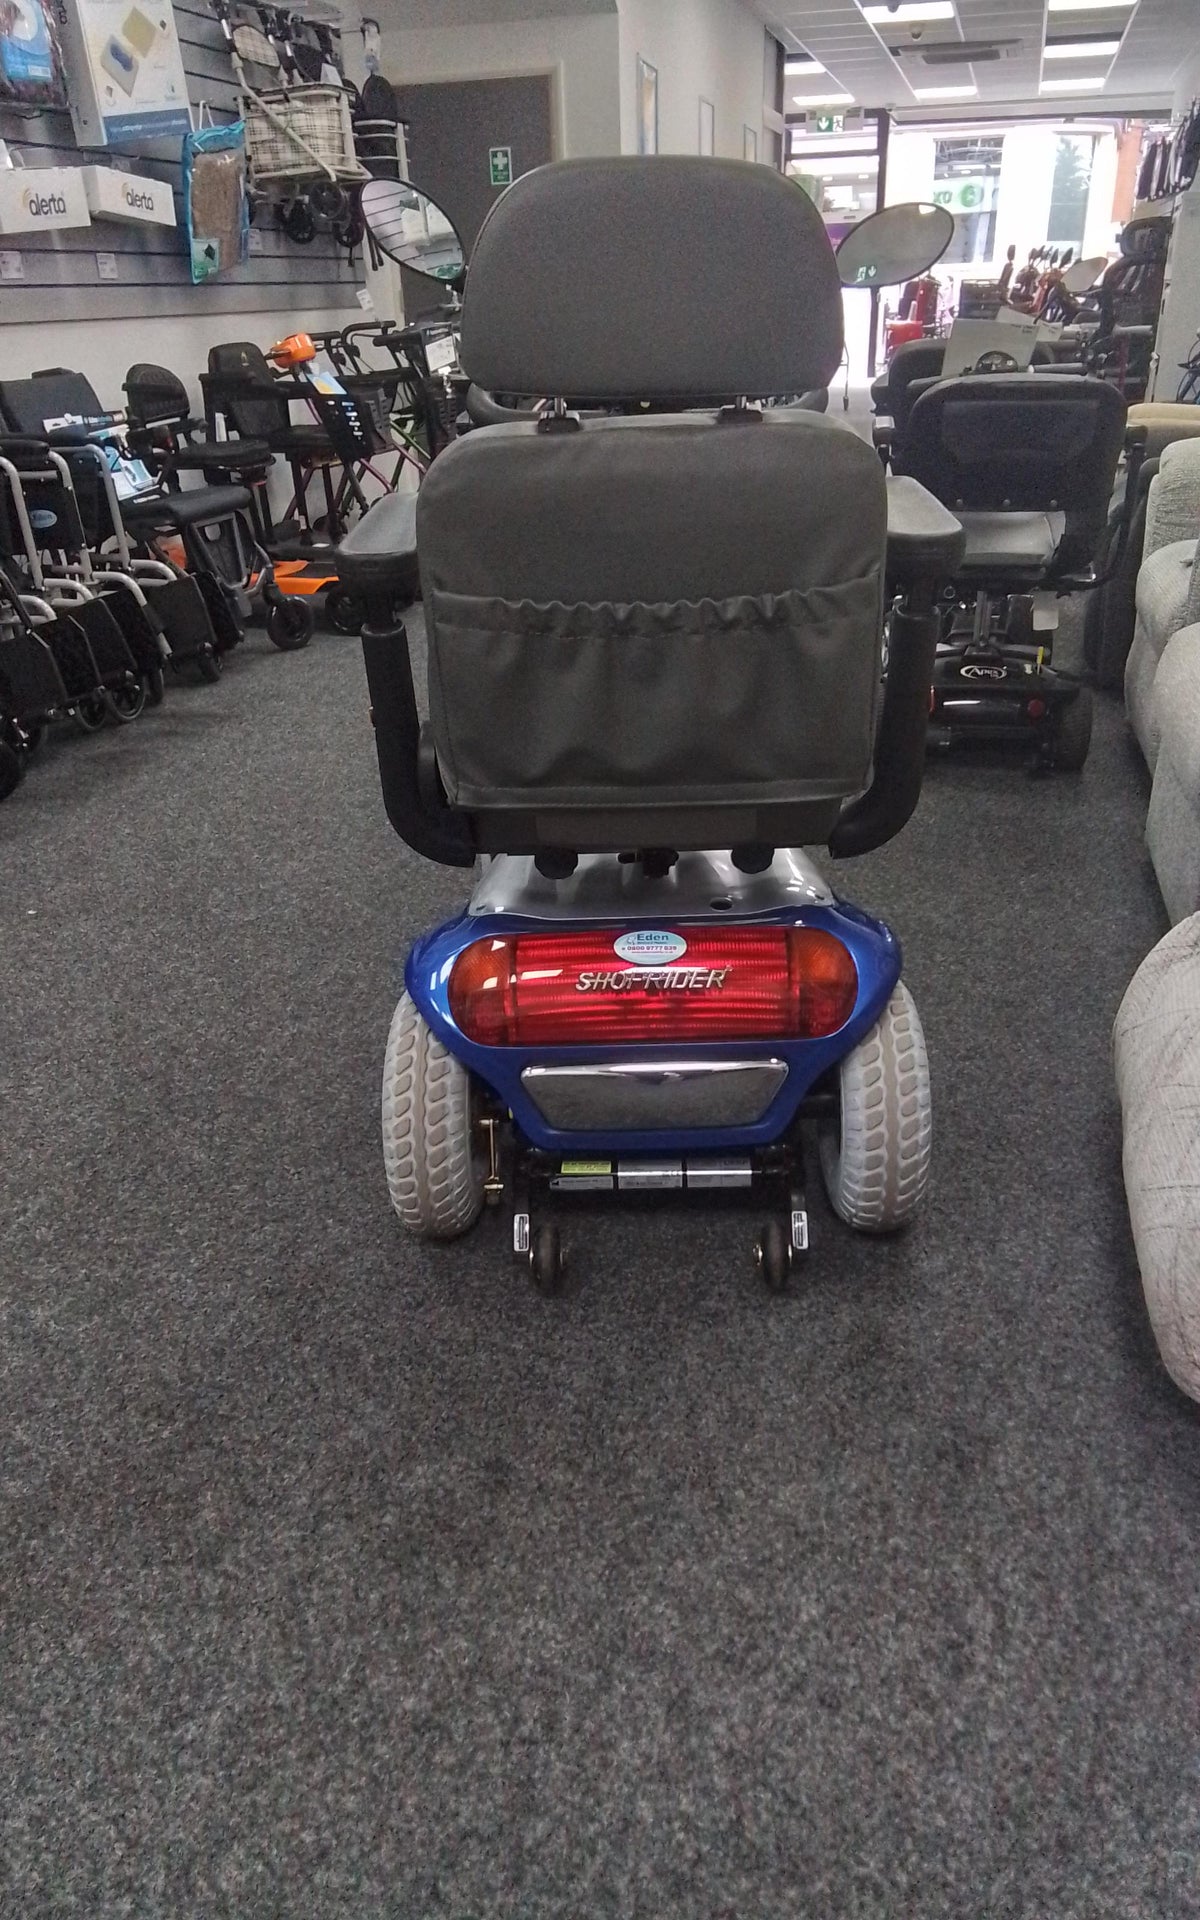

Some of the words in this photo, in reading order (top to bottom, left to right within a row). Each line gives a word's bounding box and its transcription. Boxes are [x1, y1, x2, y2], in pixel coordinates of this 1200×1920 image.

[29, 193, 66, 216] alerta
[126, 188, 154, 211] alerta
[636, 933, 669, 941] Eden
